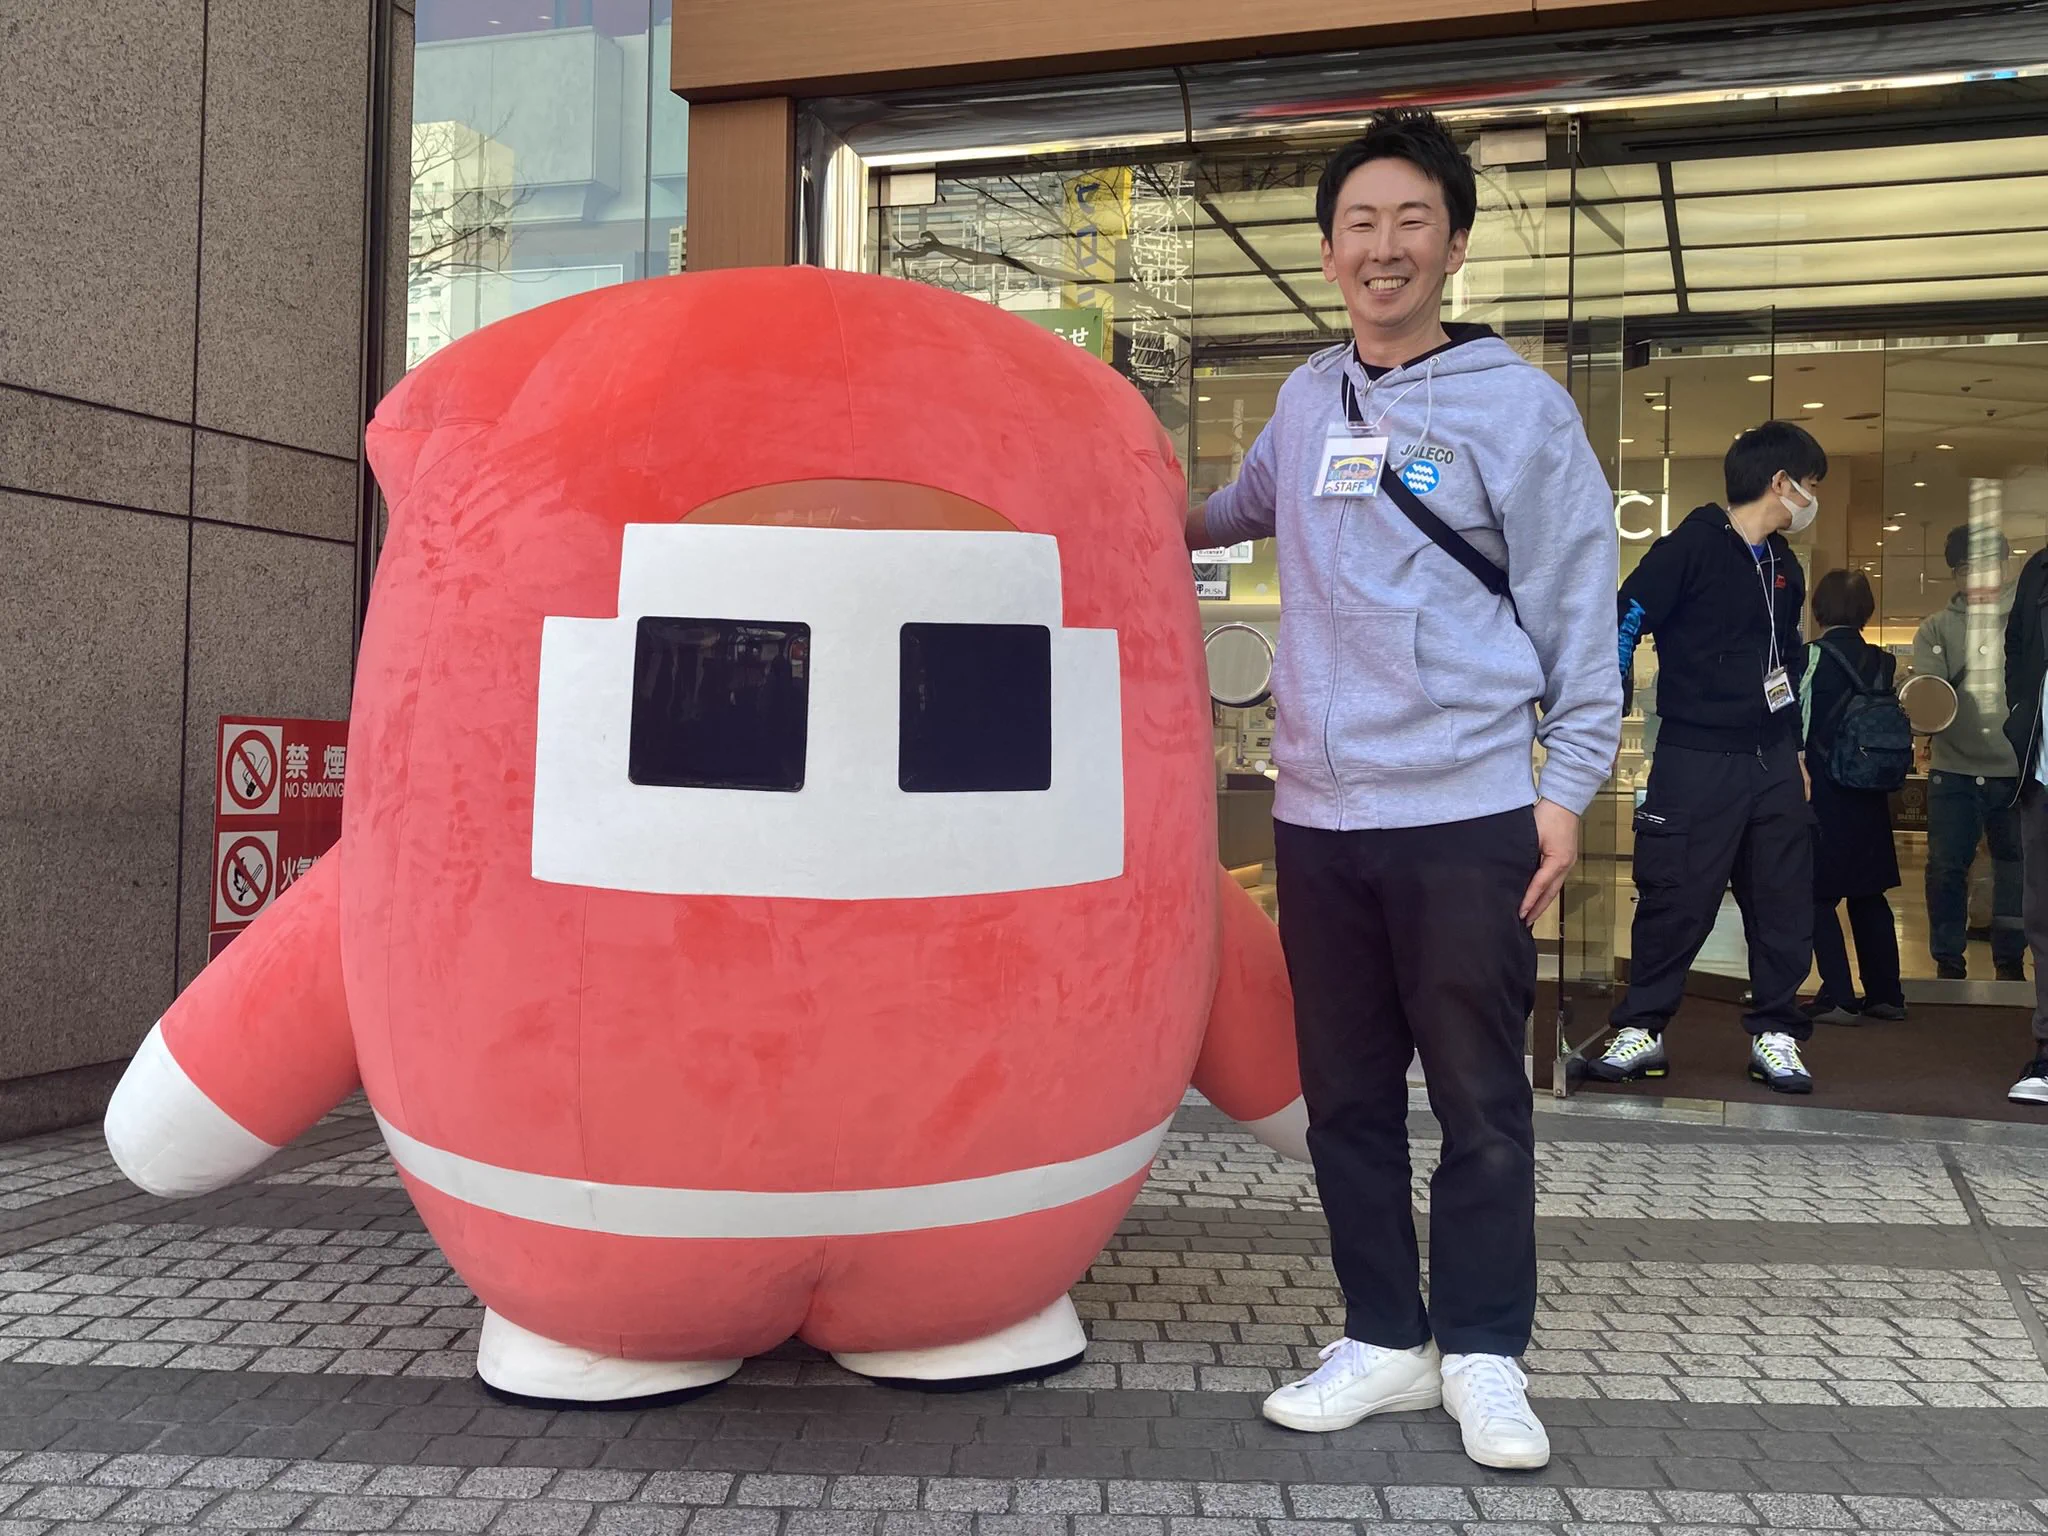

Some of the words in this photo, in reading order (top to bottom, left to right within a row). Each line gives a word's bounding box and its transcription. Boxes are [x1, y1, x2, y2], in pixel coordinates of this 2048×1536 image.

[1334, 481, 1365, 492] STAFF
[285, 743, 346, 779] 禁煙
[284, 782, 299, 798] NO
[301, 782, 345, 798] SMOKING
[280, 855, 320, 890] 火気
